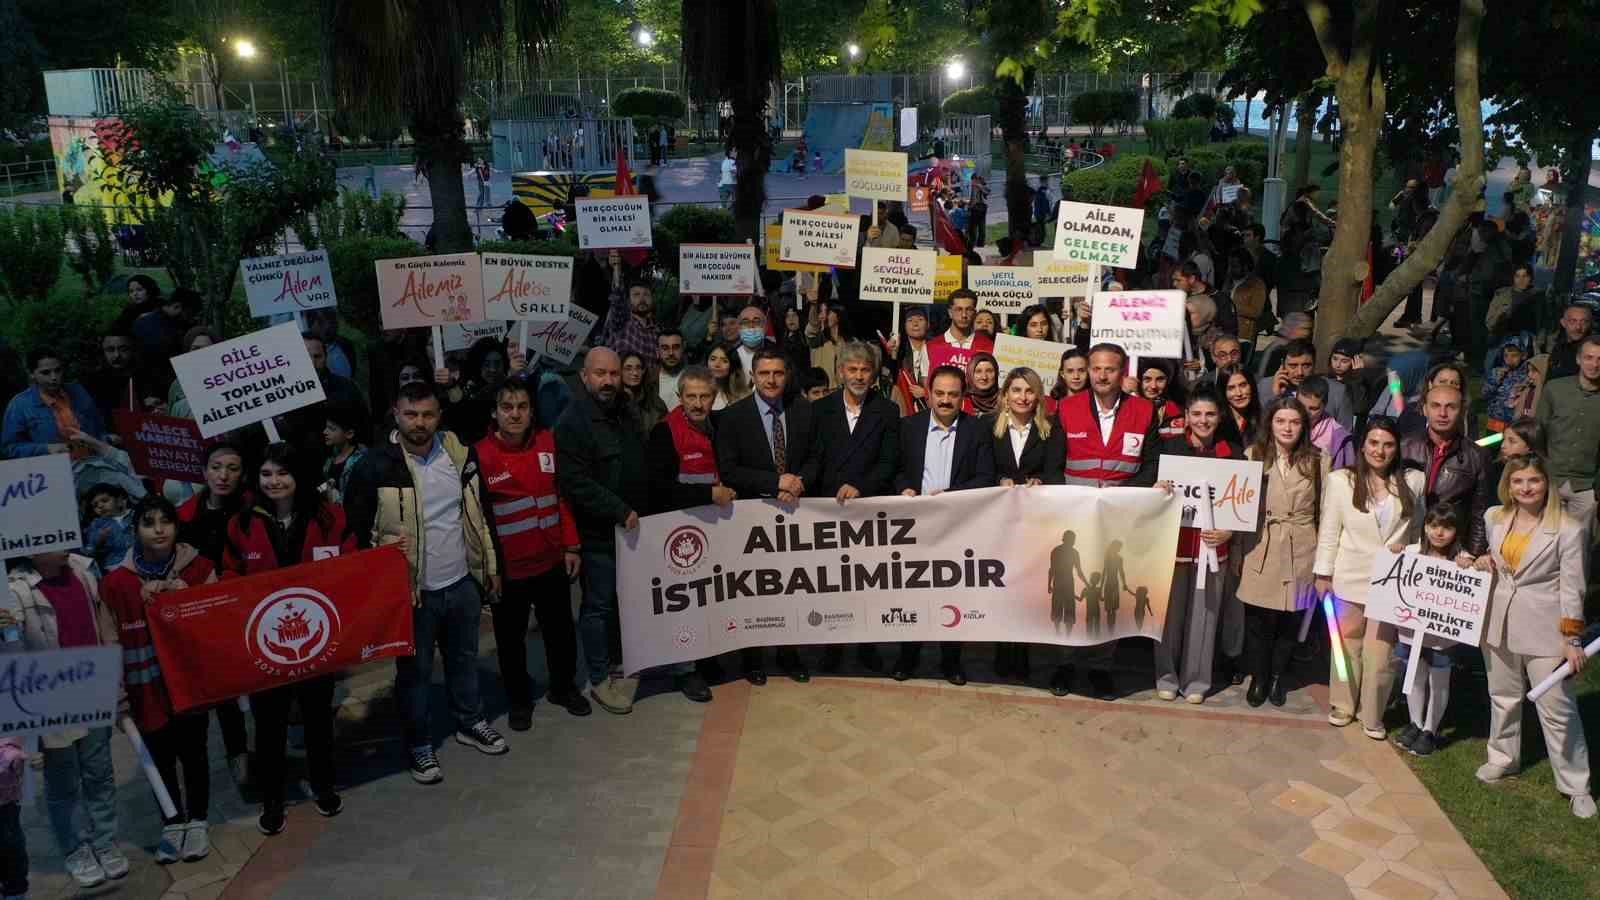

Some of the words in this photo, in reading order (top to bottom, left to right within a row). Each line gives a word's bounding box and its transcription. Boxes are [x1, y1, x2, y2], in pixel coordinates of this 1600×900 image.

[592, 214, 607, 223] BİR
[609, 213, 636, 222] AİLESİ
[1085, 207, 1116, 222] AİLE
[599, 225, 632, 233] OLMALI
[1063, 221, 1135, 240] OLMADAN,
[803, 239, 838, 250] OLMALI
[1064, 238, 1129, 254] GELECEK
[484, 257, 498, 265] EN
[500, 256, 533, 268] BÜYÜK
[535, 260, 570, 269] DESTEK
[887, 255, 911, 265] AİLE
[1069, 249, 1121, 265] OLMAZ
[245, 260, 281, 272] YALNIZ
[248, 270, 283, 284] ÇÜNKÜ
[879, 276, 917, 286] TOPLUM
[306, 291, 330, 302] VAR
[863, 284, 899, 294] AİLEYLE
[520, 303, 564, 313] SAKLI
[985, 299, 1022, 308] KÖKLER
[1121, 311, 1152, 321] VAR
[1123, 341, 1152, 352] VAR
[220, 344, 262, 367] AİLE
[203, 354, 291, 390] SEVGİYLE,
[221, 373, 286, 402] TOPLUM
[202, 396, 263, 425] AİLEYLE
[265, 379, 317, 404] BÜYÜR
[1167, 479, 1216, 500] NCE
[1215, 473, 1255, 523] Aile
[0, 529, 78, 552] İMİZDİR
[743, 511, 917, 554] AİLEMİZ
[652, 548, 1006, 616] İSTİKBALİMİZDİR
[1371, 553, 1424, 609] Aile
[1425, 565, 1482, 588] BİRLİKTE
[1429, 577, 1476, 598] YÜRÜR,
[1415, 591, 1481, 615] KALPLER
[1417, 608, 1474, 630] BİRLİKTE
[1426, 621, 1461, 637] ATAR
